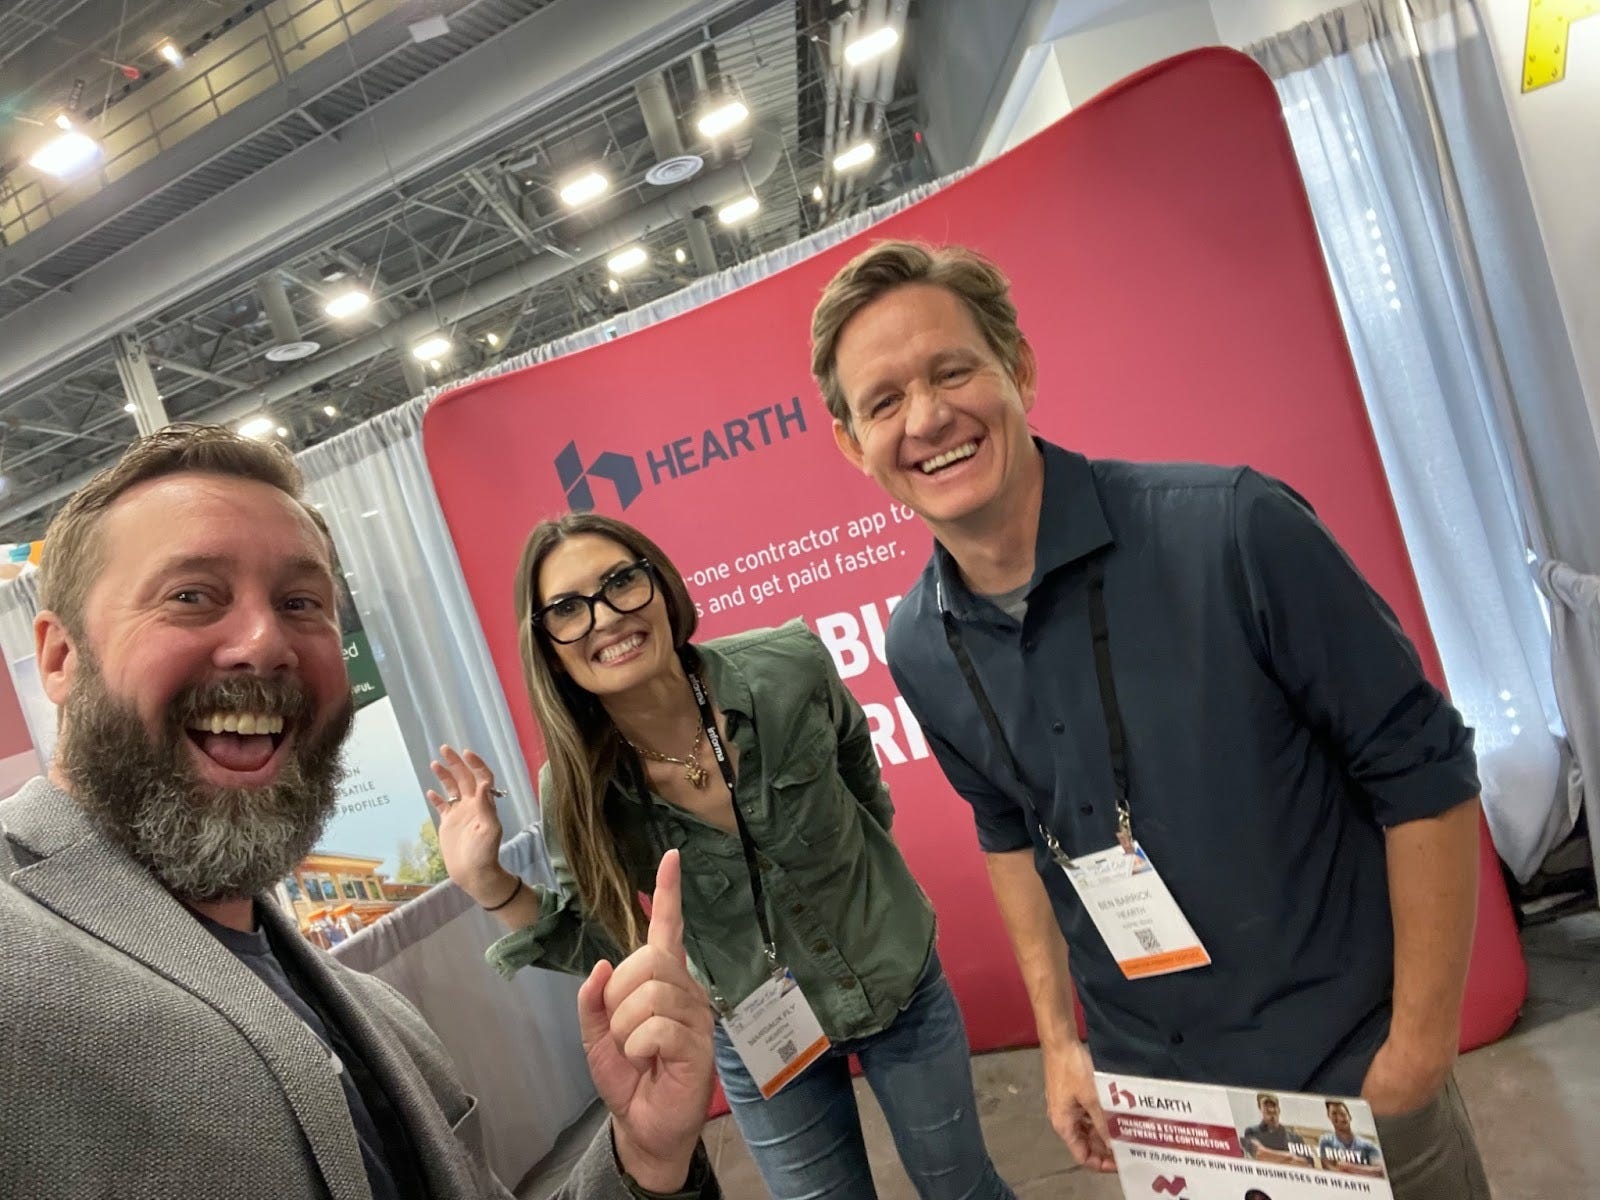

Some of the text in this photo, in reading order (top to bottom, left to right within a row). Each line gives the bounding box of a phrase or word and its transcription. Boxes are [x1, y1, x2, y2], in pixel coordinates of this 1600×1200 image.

[646, 396, 807, 485] HEARTH
[684, 503, 914, 586] -one contractor app to
[708, 585, 745, 614] and
[750, 574, 783, 604] get
[787, 558, 832, 594] paid
[835, 541, 906, 574] faster.
[815, 595, 902, 680] BU
[707, 727, 725, 762] informa
[861, 695, 930, 768] RI
[340, 780, 376, 797] SATILE
[341, 795, 391, 815] PROFILES
[1138, 1095, 1192, 1113] HEARTH
[1160, 1133, 1174, 1143] FOR
[1175, 1134, 1231, 1151] CONTRACTORS
[1164, 1123, 1209, 1138] ESTIMATING
[1130, 1148, 1147, 1158] WHY
[1185, 1156, 1208, 1168] PROS
[1209, 1160, 1226, 1171] RUN
[1229, 1163, 1254, 1175] THEIR
[1256, 1167, 1313, 1184] BUSINESSES
[1315, 1175, 1329, 1186] ON
[1330, 1178, 1371, 1193] HEARTH
